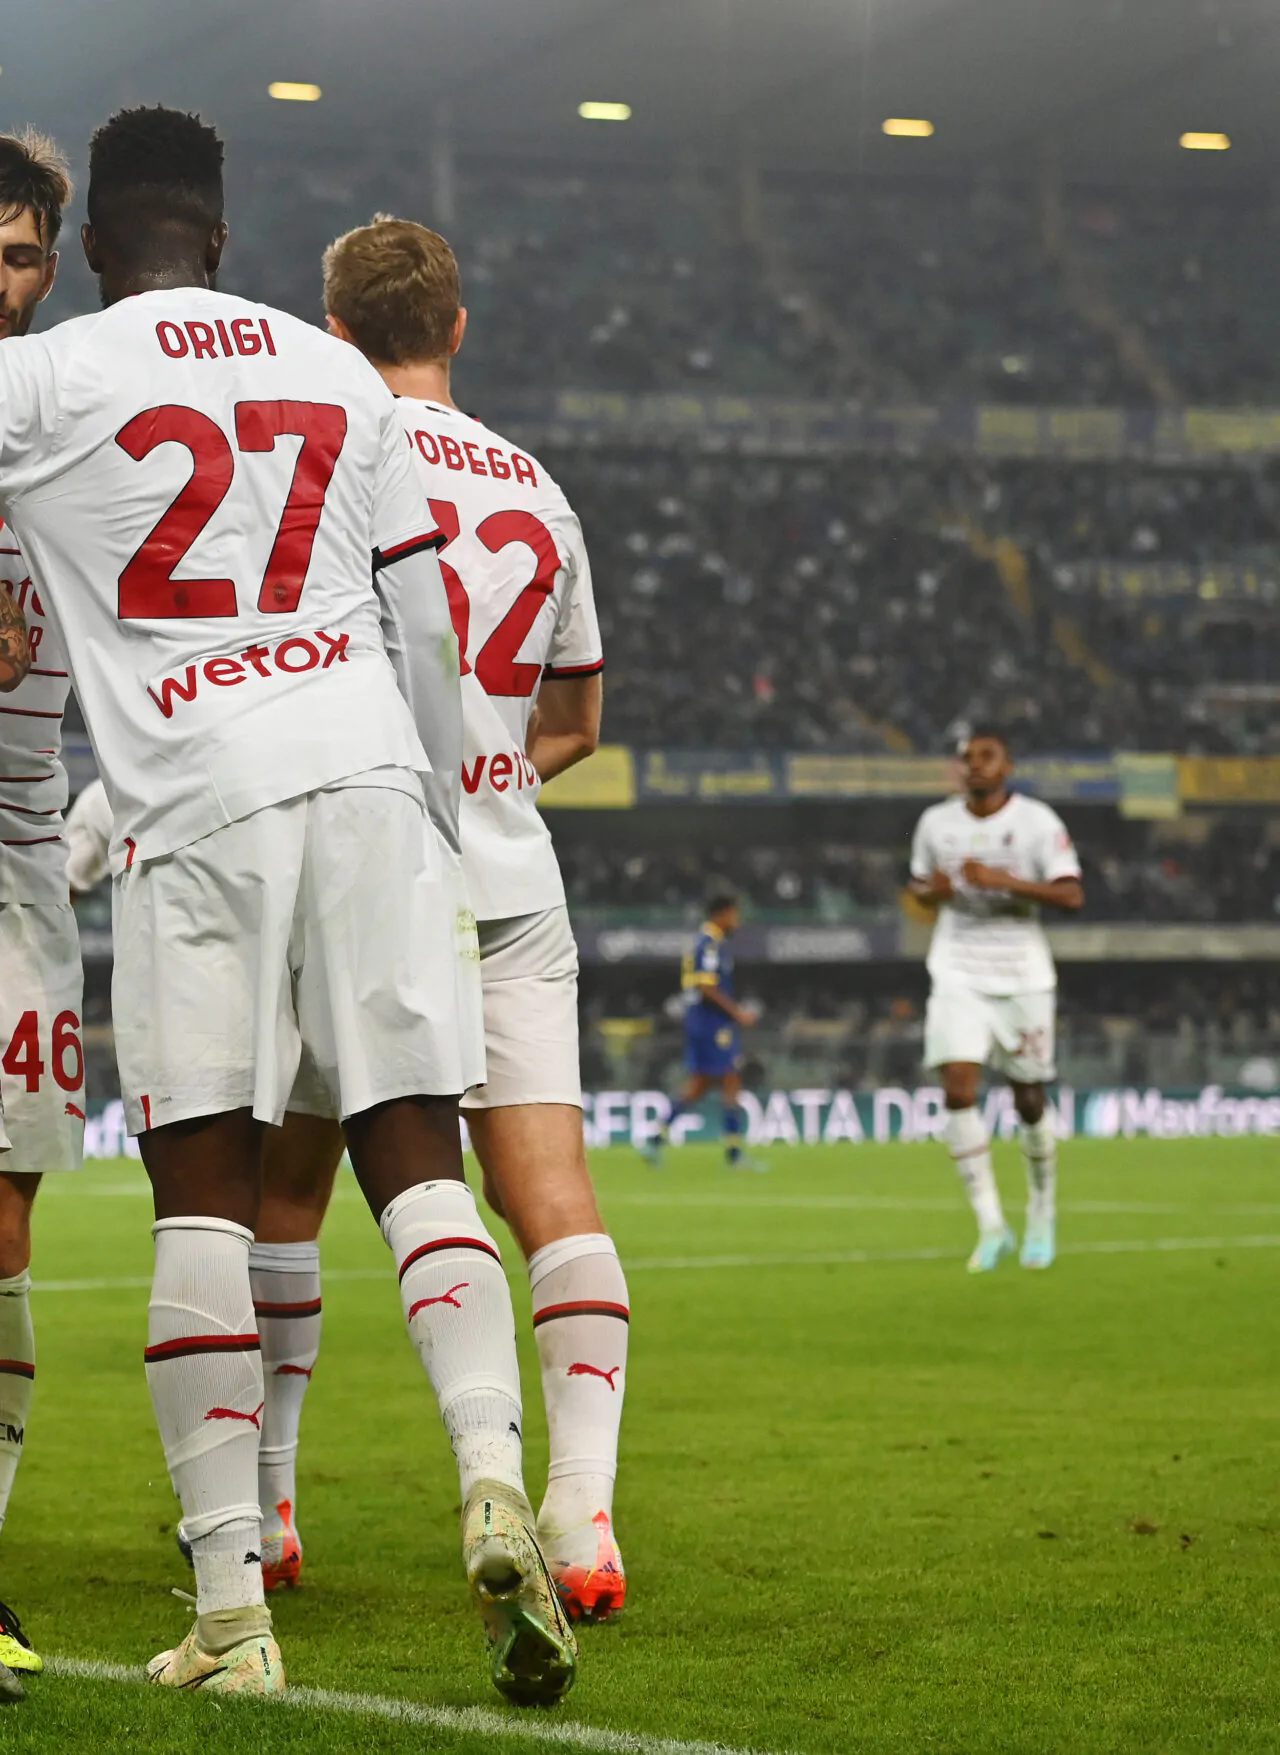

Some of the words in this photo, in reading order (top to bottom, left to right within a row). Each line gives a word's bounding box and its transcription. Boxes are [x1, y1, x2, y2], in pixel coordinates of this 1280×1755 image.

[156, 318, 277, 359] ORIGI
[404, 428, 538, 488] OBEGA
[115, 400, 348, 619] 27
[1, 1009, 84, 1093] 46
